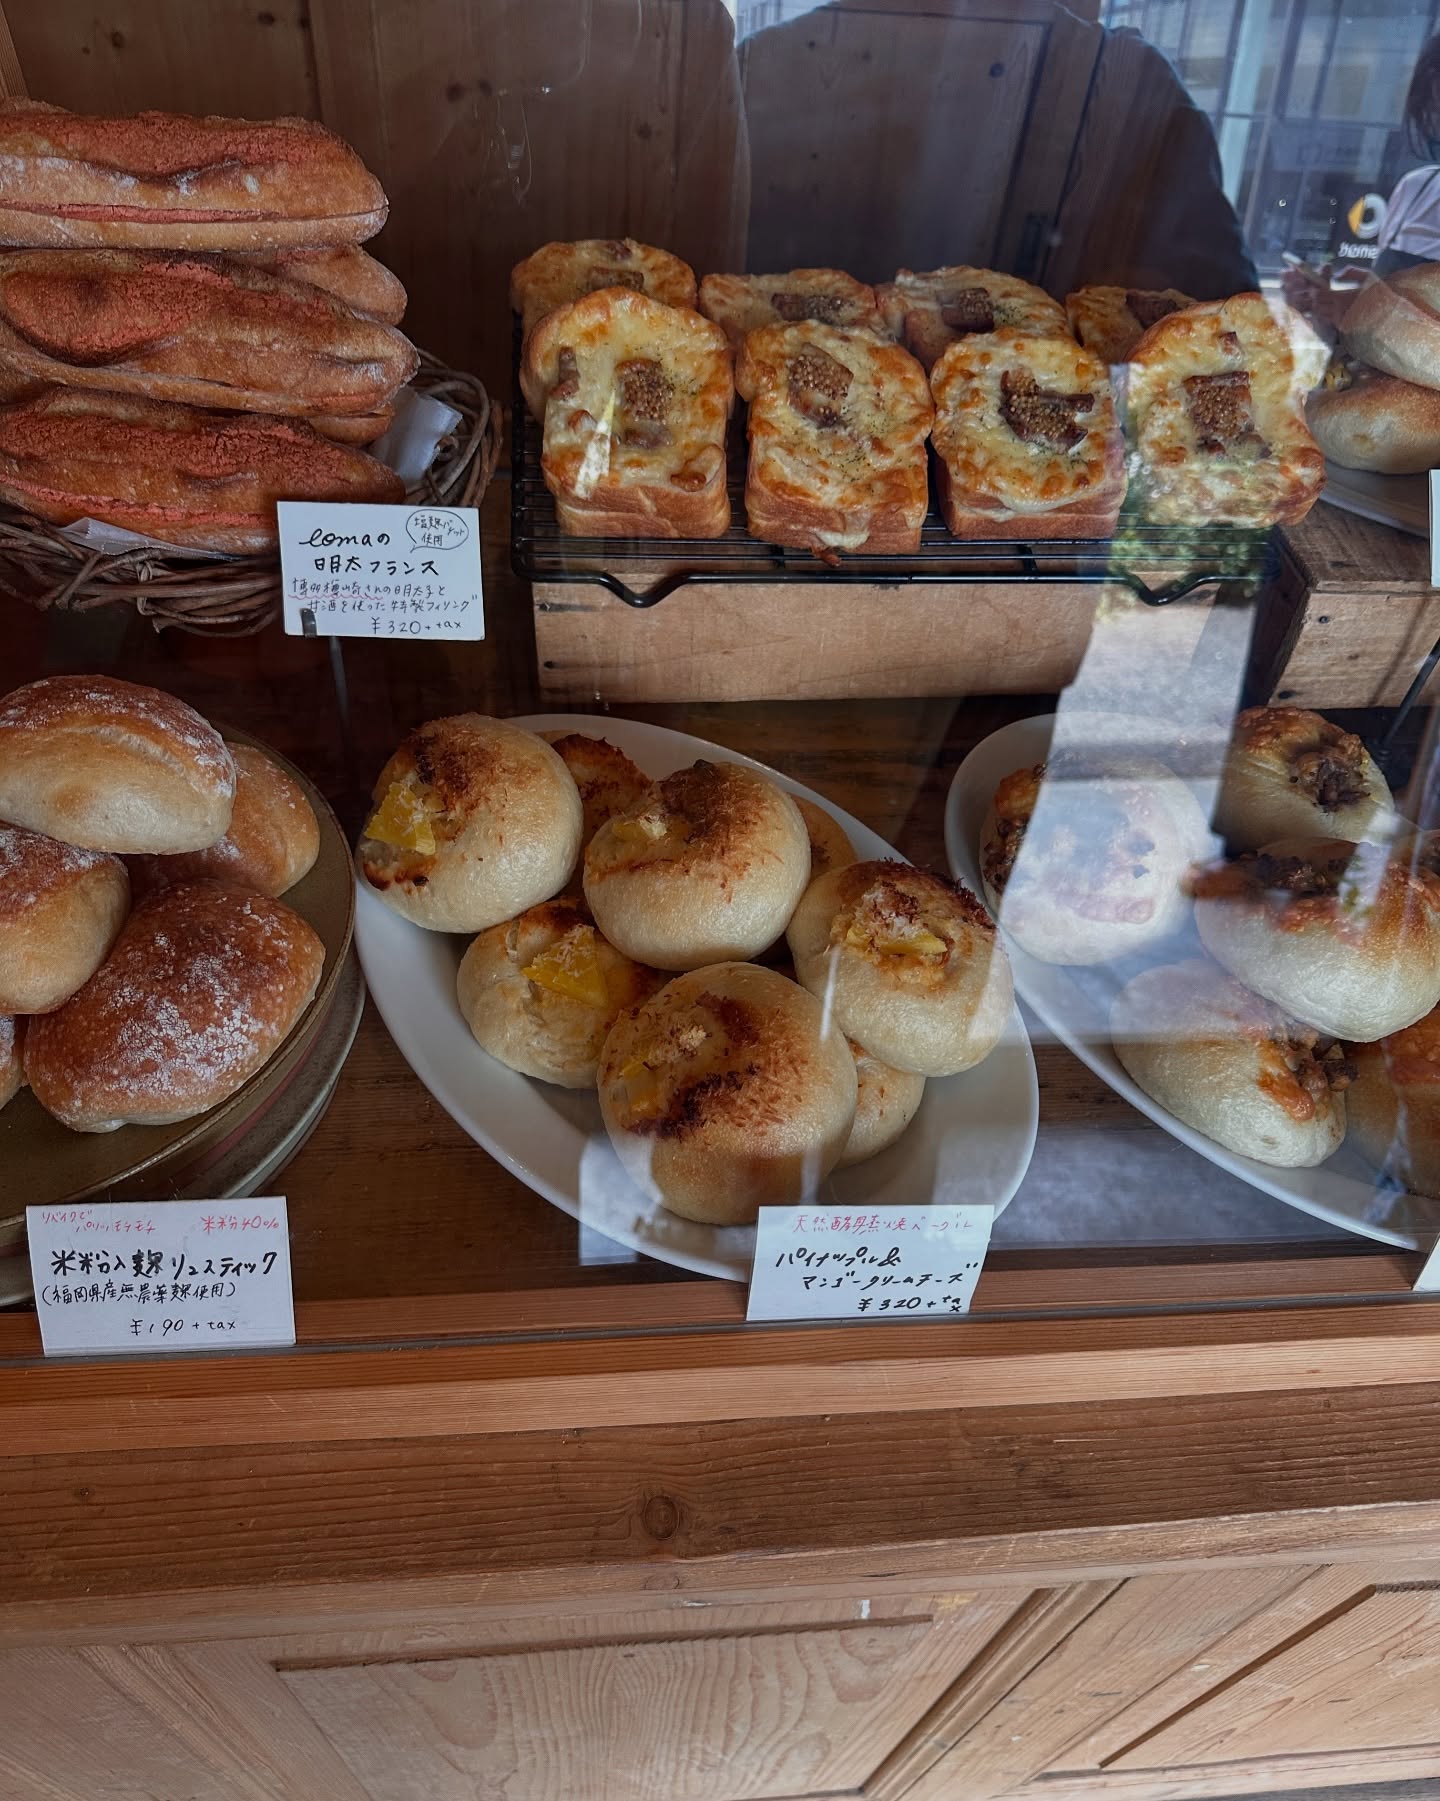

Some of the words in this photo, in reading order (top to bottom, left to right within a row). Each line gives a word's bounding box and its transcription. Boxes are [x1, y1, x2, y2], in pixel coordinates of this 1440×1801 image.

[314, 555, 440, 576] 明太フランス
